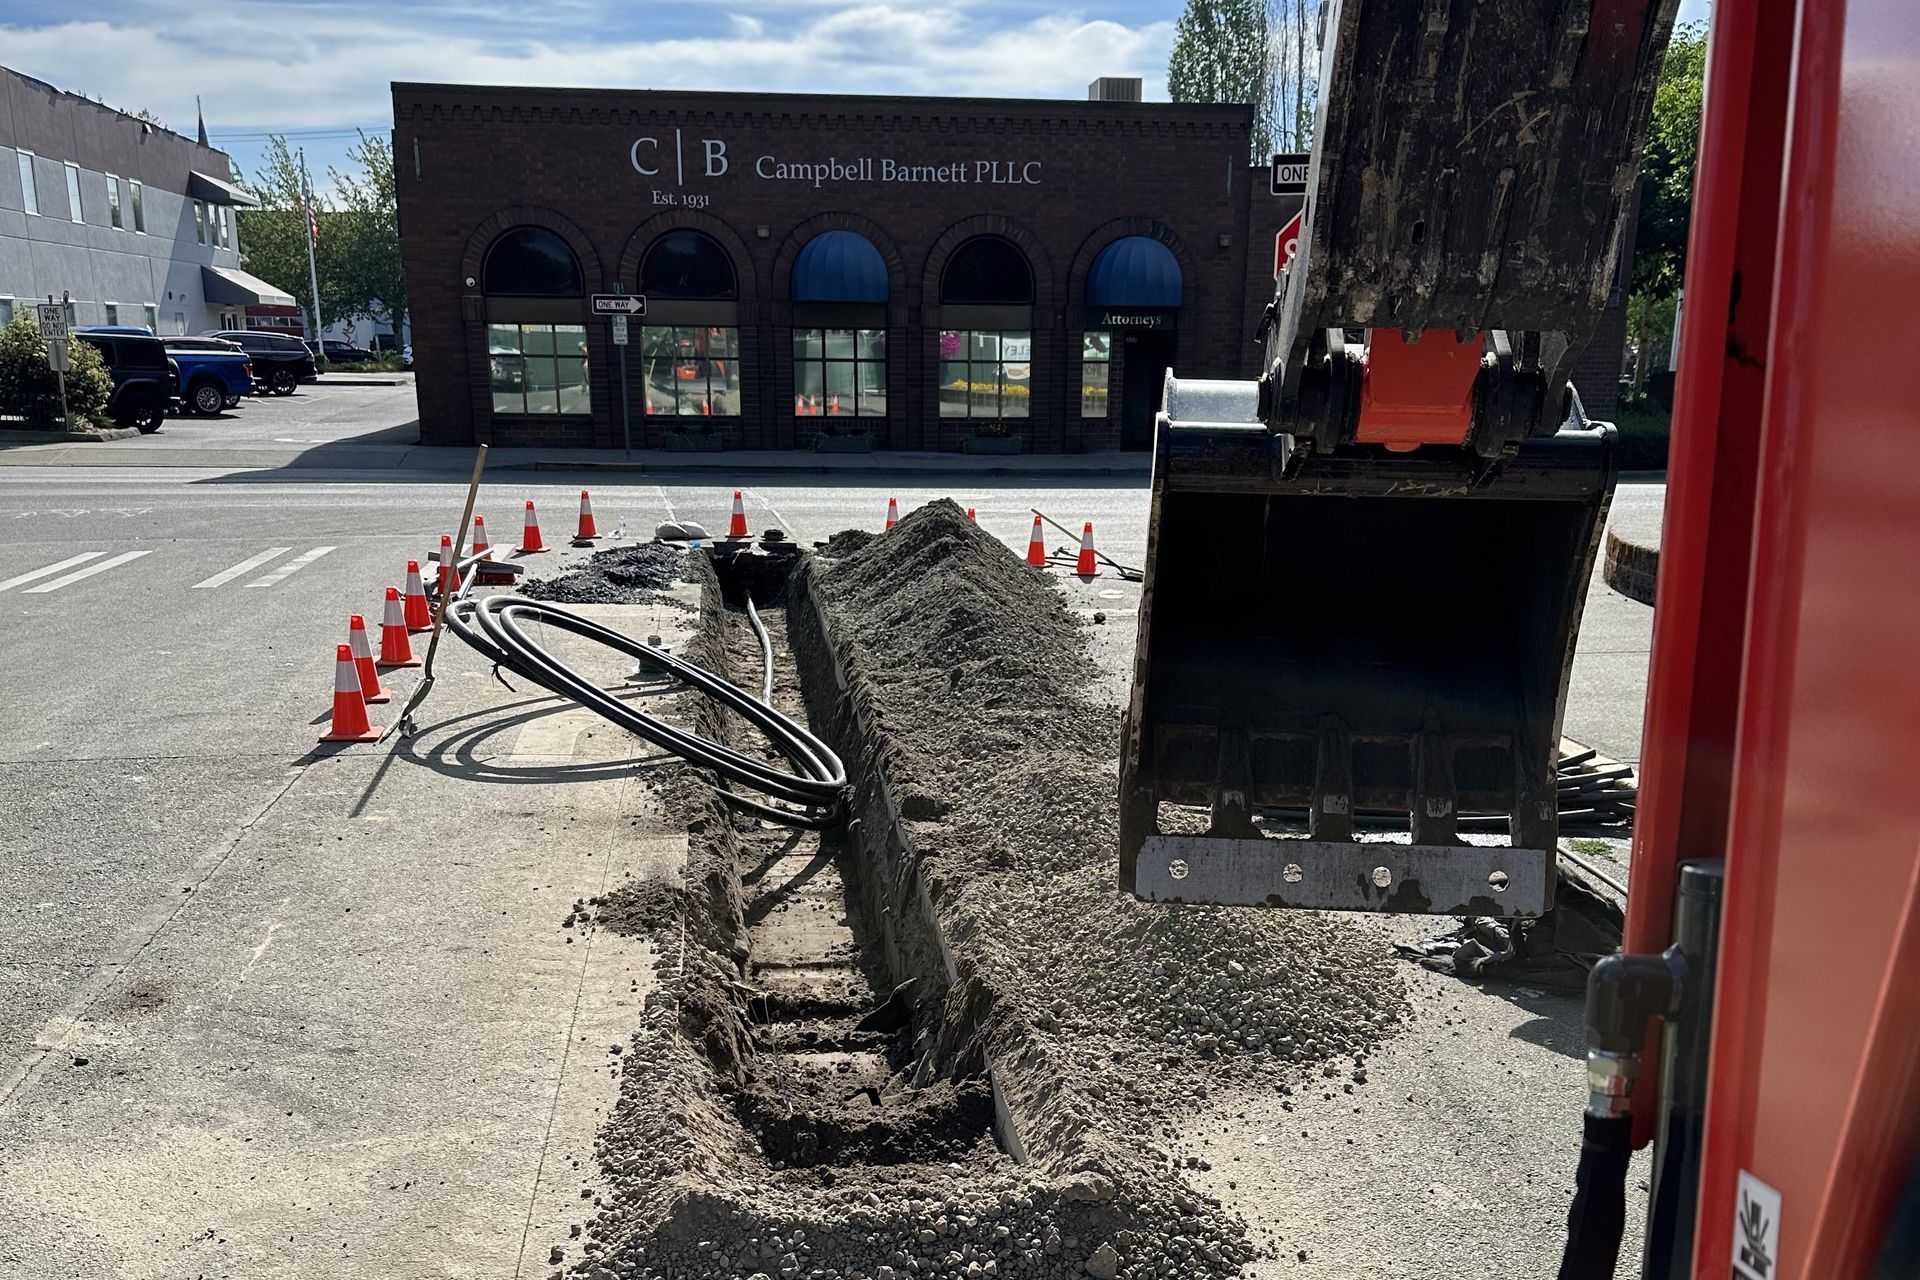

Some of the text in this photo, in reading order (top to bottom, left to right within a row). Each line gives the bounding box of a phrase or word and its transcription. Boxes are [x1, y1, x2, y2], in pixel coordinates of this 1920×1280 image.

[630, 137, 728, 176] C B
[755, 155, 1042, 188] Campbell Barnett PLLC
[652, 190, 711, 209] Est. 1931
[42, 322, 65, 330] DO NOT
[1101, 312, 1162, 328] Attorneys
